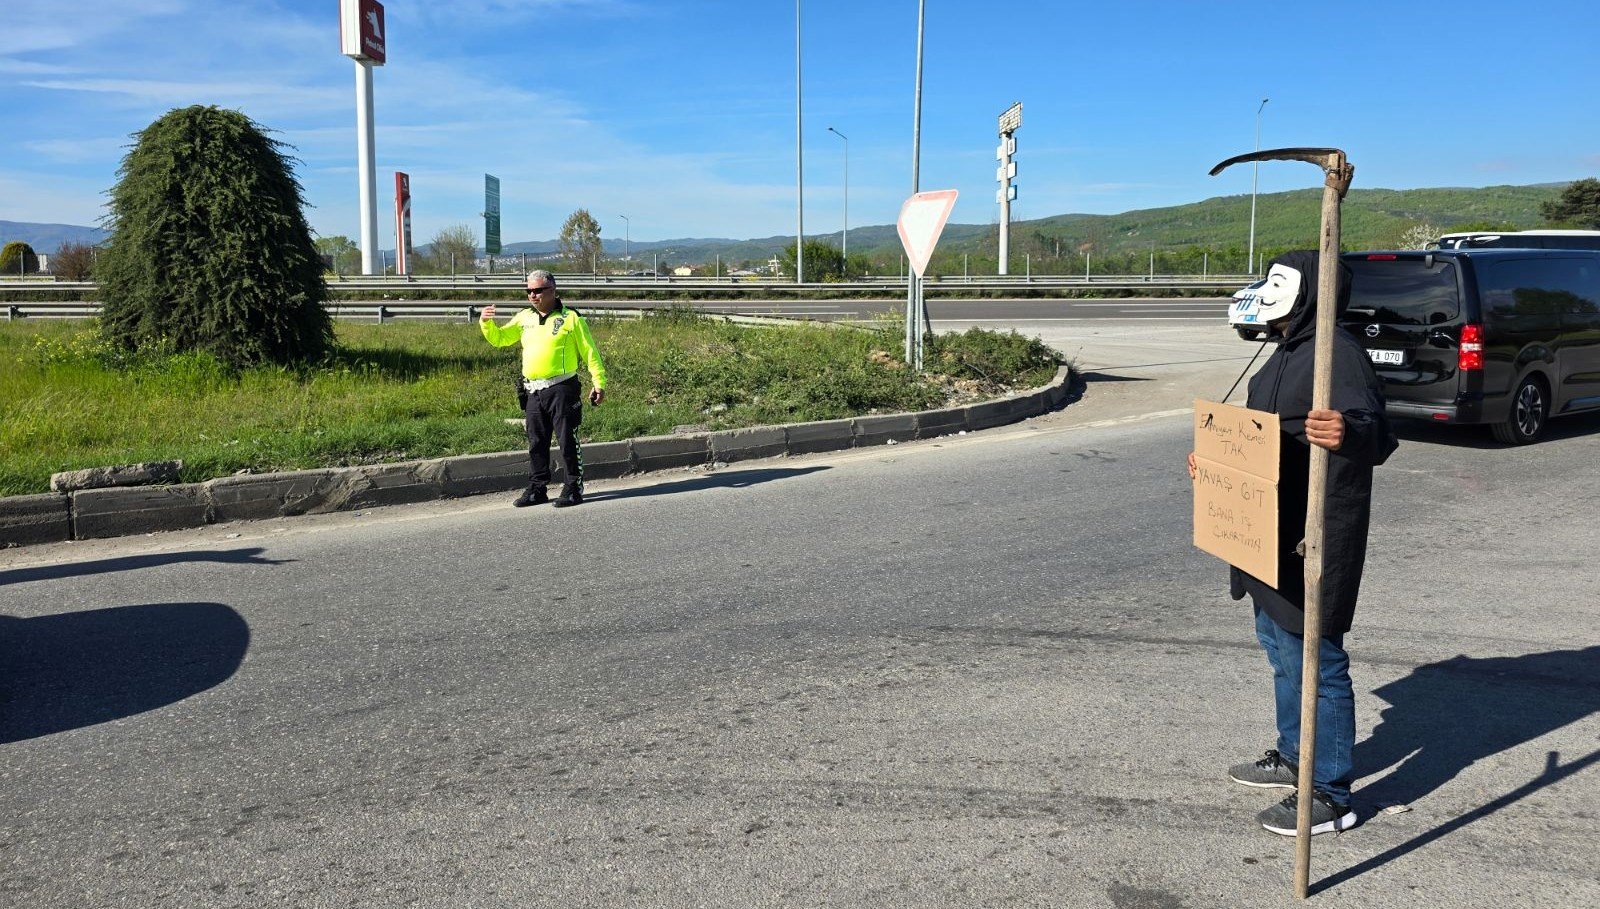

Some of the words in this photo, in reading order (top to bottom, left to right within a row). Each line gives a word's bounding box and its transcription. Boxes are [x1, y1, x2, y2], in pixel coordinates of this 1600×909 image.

[1385, 352, 1400, 361] 070
[1220, 440, 1247, 460] TAK
[1198, 466, 1233, 493] YAVAŞ
[1208, 500, 1234, 524] BANA
